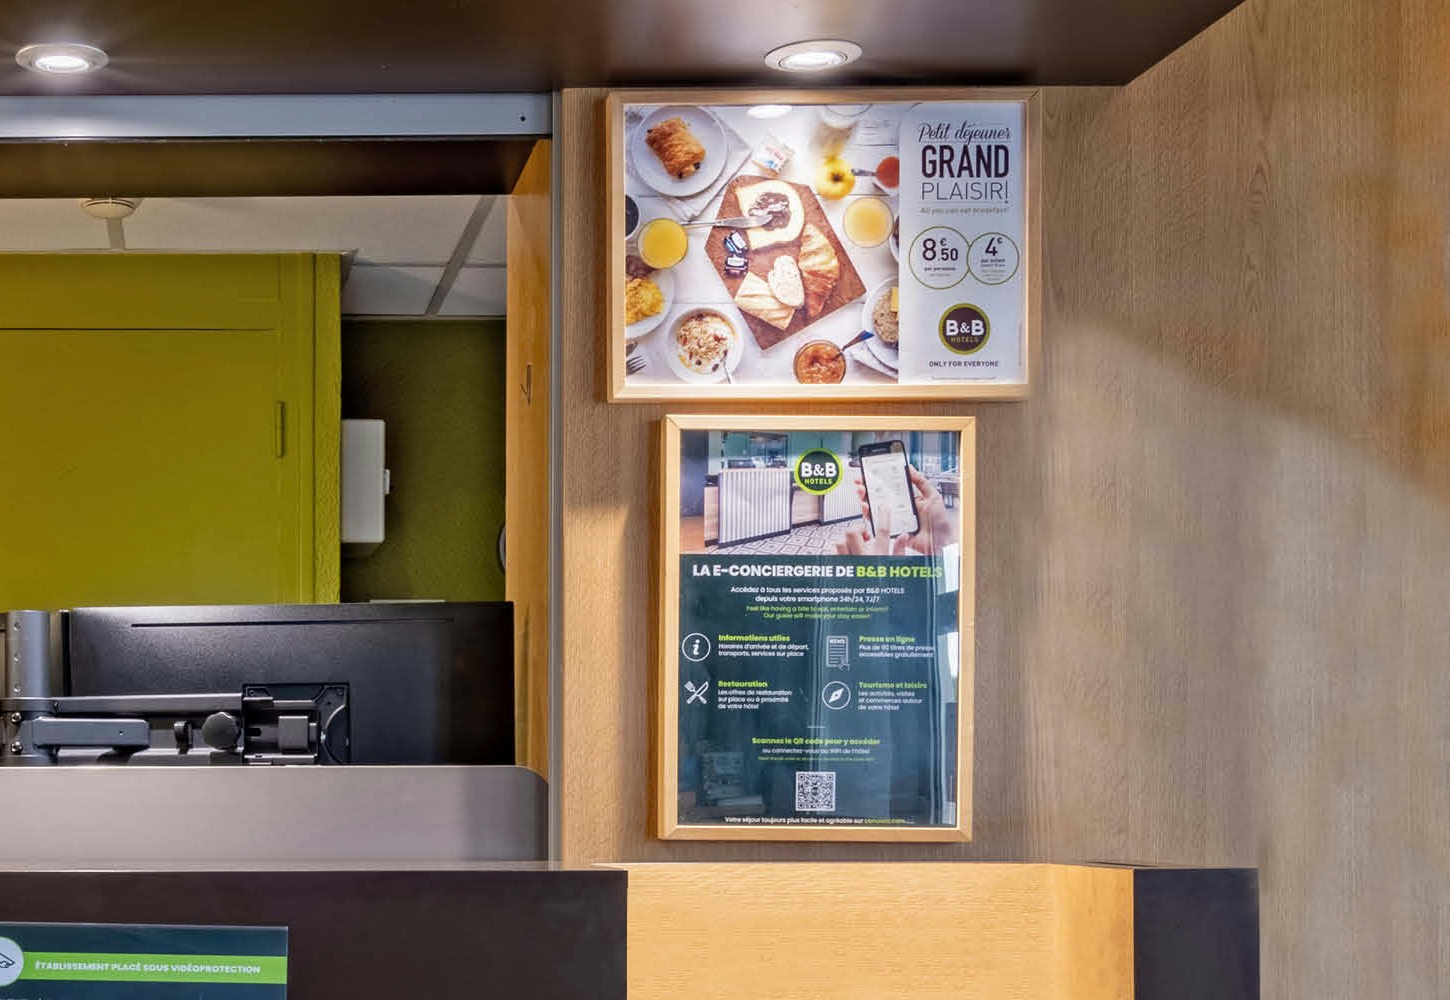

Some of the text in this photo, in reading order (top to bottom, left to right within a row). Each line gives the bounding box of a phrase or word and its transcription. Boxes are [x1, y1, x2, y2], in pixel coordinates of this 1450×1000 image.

[918, 121, 1012, 144] Petit déjeuner
[922, 144, 1010, 178] GRAND
[922, 180, 1008, 203] PLAISIR!
[946, 320, 984, 336] B&B
[928, 360, 999, 368] ONLY FOR EVERYONE
[801, 462, 836, 477] B&B
[692, 564, 943, 578] LA E-CONCIERGERIE DE B&B HOTELS
[35, 960, 261, 973] ÉTABLISSEMENT PLACÉ SOUS VIDÉOPROTECTION
